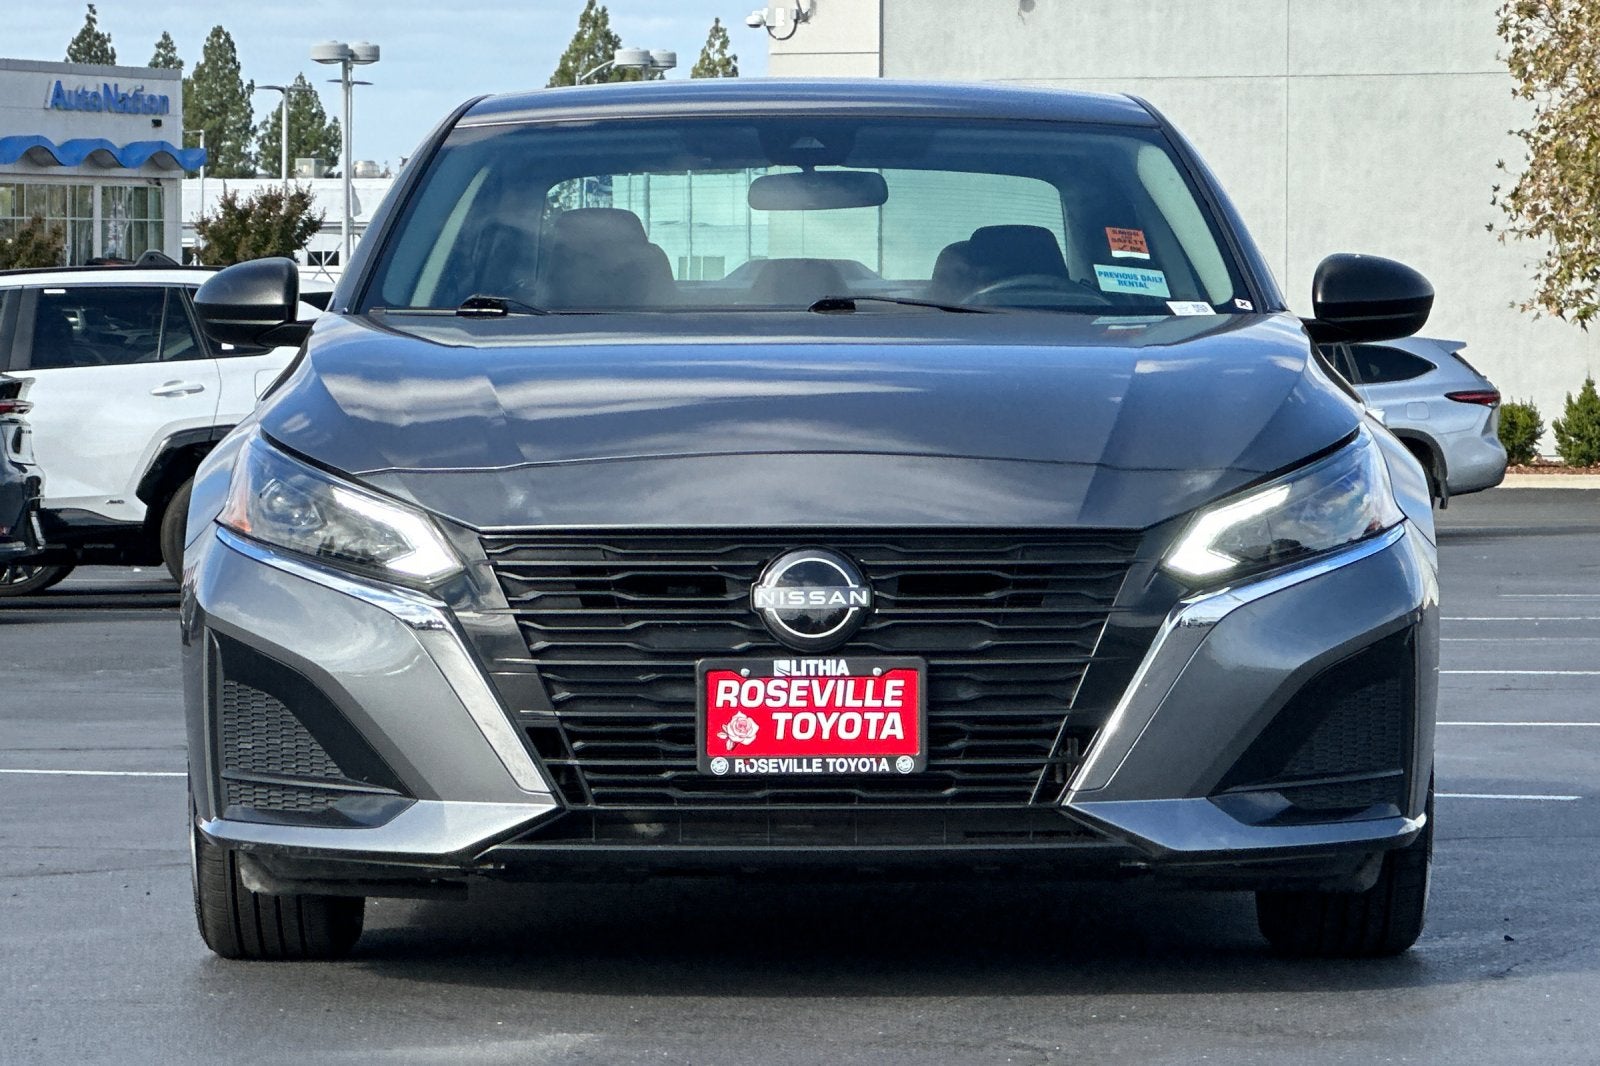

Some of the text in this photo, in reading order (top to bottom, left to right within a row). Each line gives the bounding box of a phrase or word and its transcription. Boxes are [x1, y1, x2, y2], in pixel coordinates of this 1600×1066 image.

[48, 80, 169, 114] AutoNation
[1097, 270, 1163, 284] PREVIOUS DAILY
[1117, 279, 1150, 289] RENTAL
[758, 590, 867, 605] NISSAN
[791, 659, 850, 676] LITHIA
[715, 679, 905, 708] ROSEVILLE
[771, 712, 905, 740] TOYOTA
[734, 758, 822, 774] ROSEVILLE
[826, 757, 890, 773] TOYOTA
